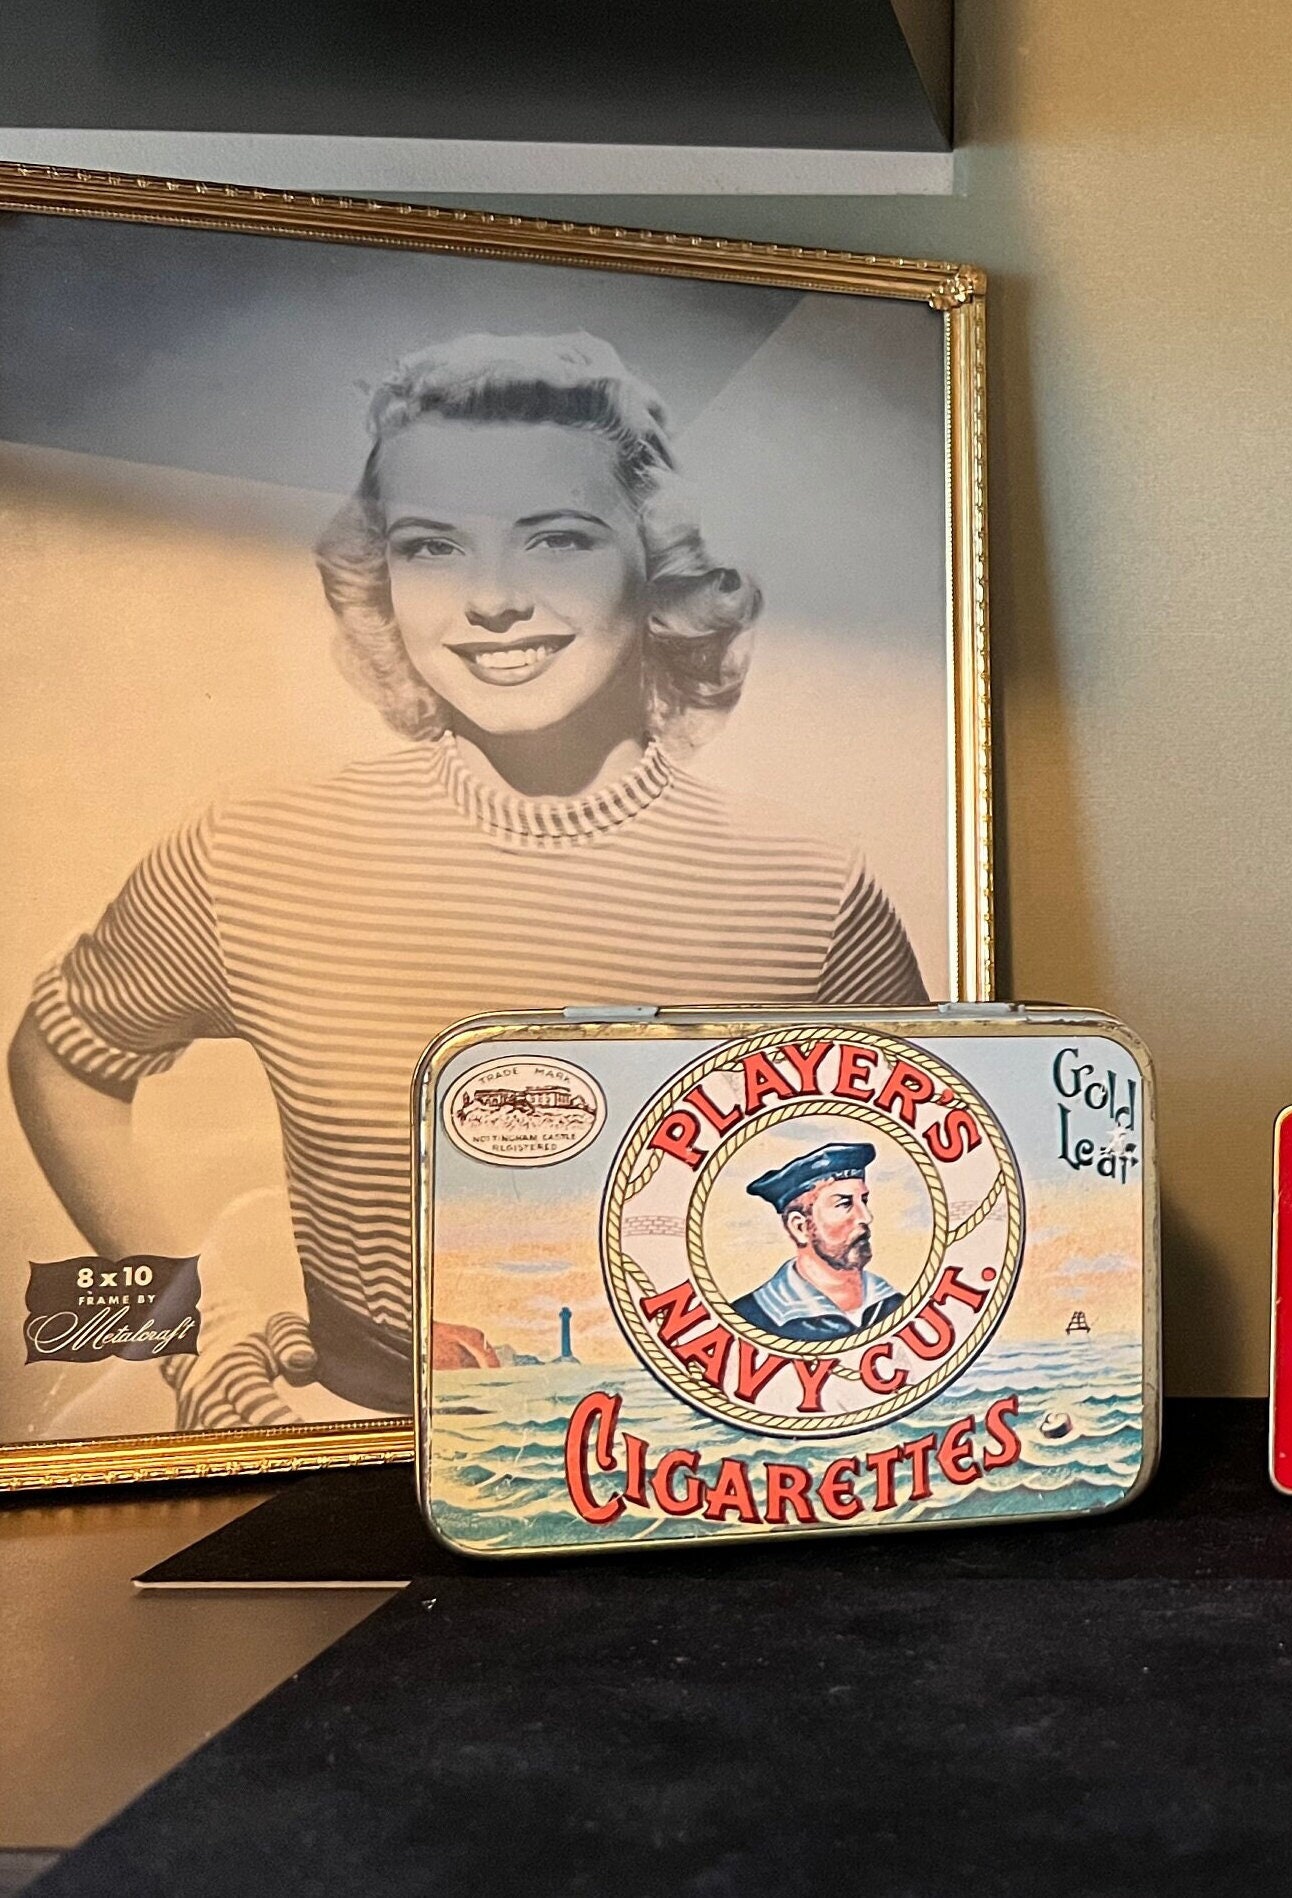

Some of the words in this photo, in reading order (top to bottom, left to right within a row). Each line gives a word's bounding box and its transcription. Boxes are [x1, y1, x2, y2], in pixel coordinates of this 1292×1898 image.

[478, 1066, 520, 1084] TRADE
[534, 1067, 571, 1083] MARK
[651, 1039, 983, 1172] PLAYER'S
[1052, 1047, 1137, 1131] Gold
[27, 1305, 196, 1354] Metalcraft
[78, 1294, 130, 1306] FRAME
[138, 1294, 156, 1304] BY
[639, 1279, 841, 1414] NAVY
[857, 1263, 999, 1396] CUT.
[564, 1390, 1022, 1526] CIGARETTES
